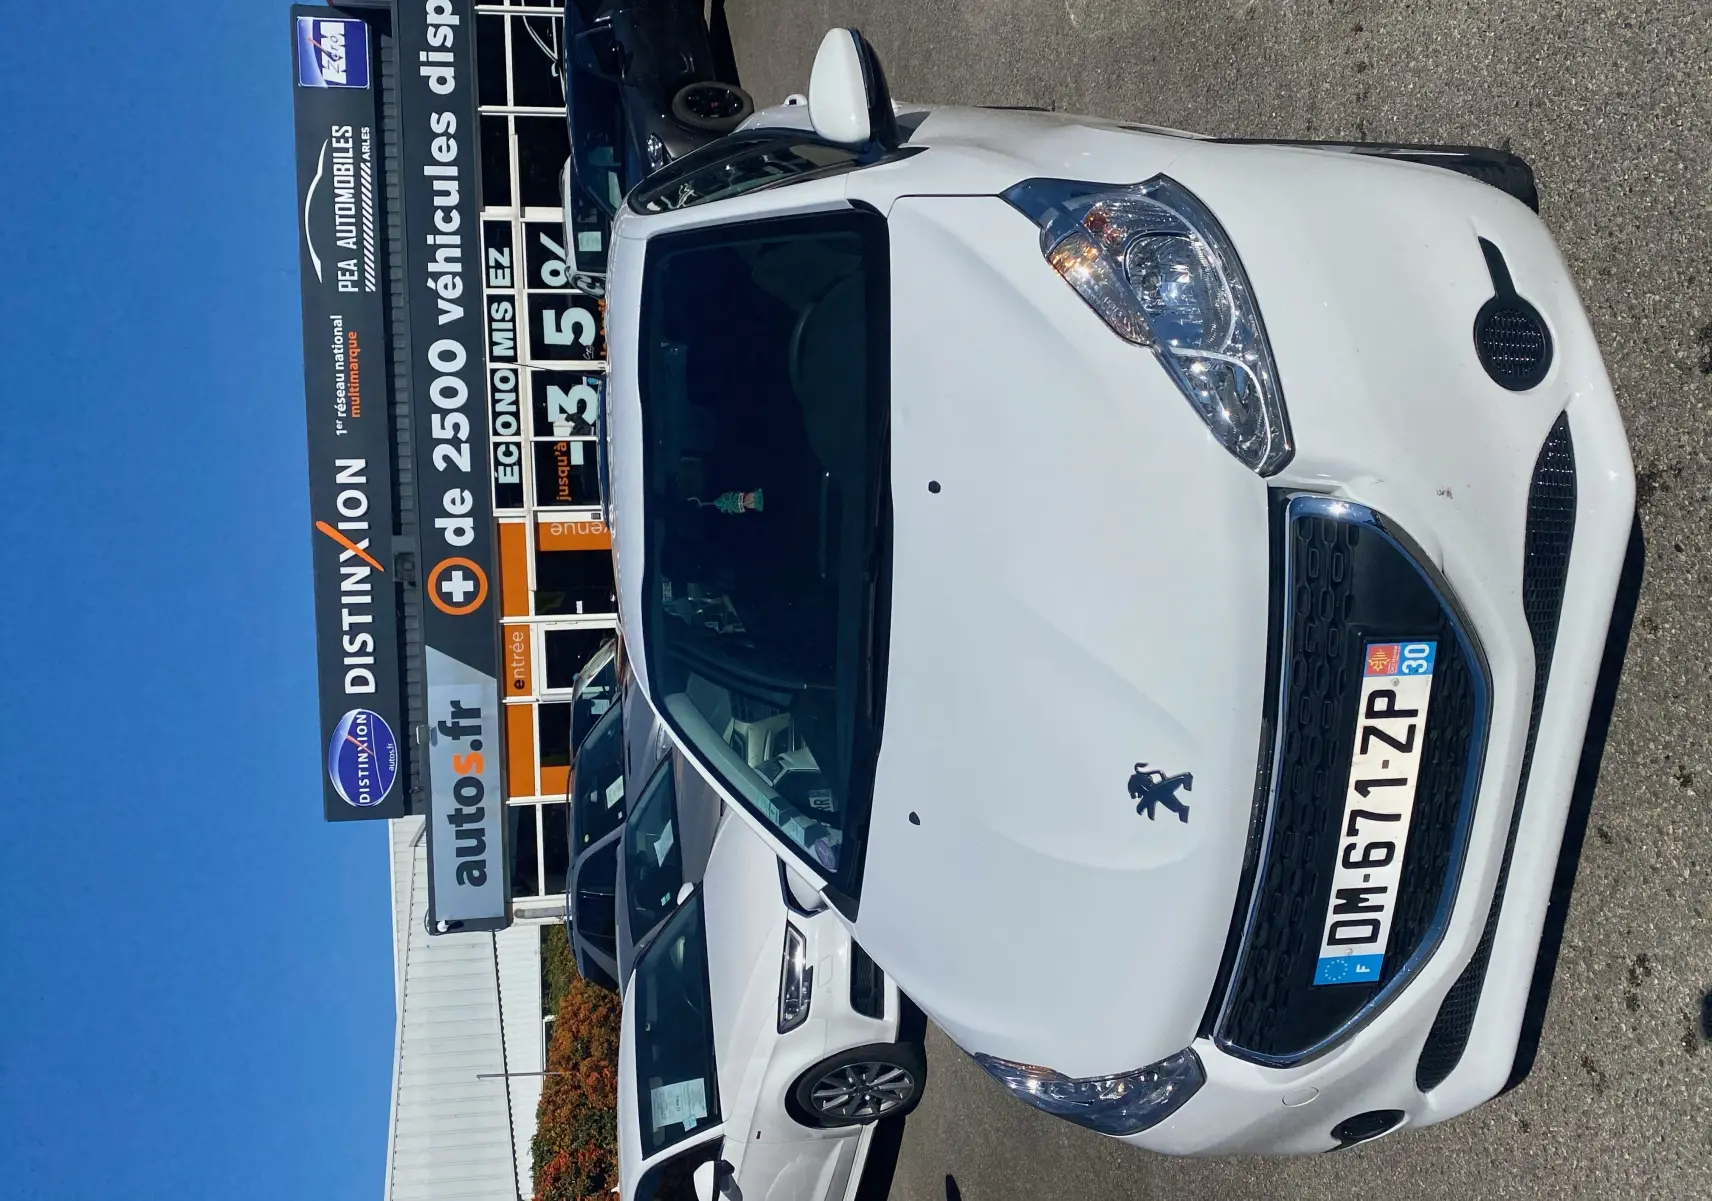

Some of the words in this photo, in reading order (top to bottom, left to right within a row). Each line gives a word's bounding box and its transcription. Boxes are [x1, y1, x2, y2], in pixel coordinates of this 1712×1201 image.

[361, 127, 370, 160] ARLES
[331, 125, 357, 249] AUTOMOBILES
[423, 111, 464, 325] véhicules
[337, 259, 359, 292] PEA
[330, 315, 344, 370] national
[334, 373, 346, 417] réseau
[347, 331, 361, 418] multimarque
[427, 338, 471, 472] 2500
[553, 441, 572, 501] jusqu'à
[434, 488, 475, 546] de
[325, 459, 382, 694] DISTINXION
[510, 631, 525, 690] entrée
[1402, 644, 1430, 674] 30
[350, 714, 372, 803] DISTINXION
[386, 743, 395, 771] autos.fr
[438, 700, 487, 887] autos.fr
[1326, 689, 1419, 946] DM-671-ZP
[1356, 964, 1370, 973] F
